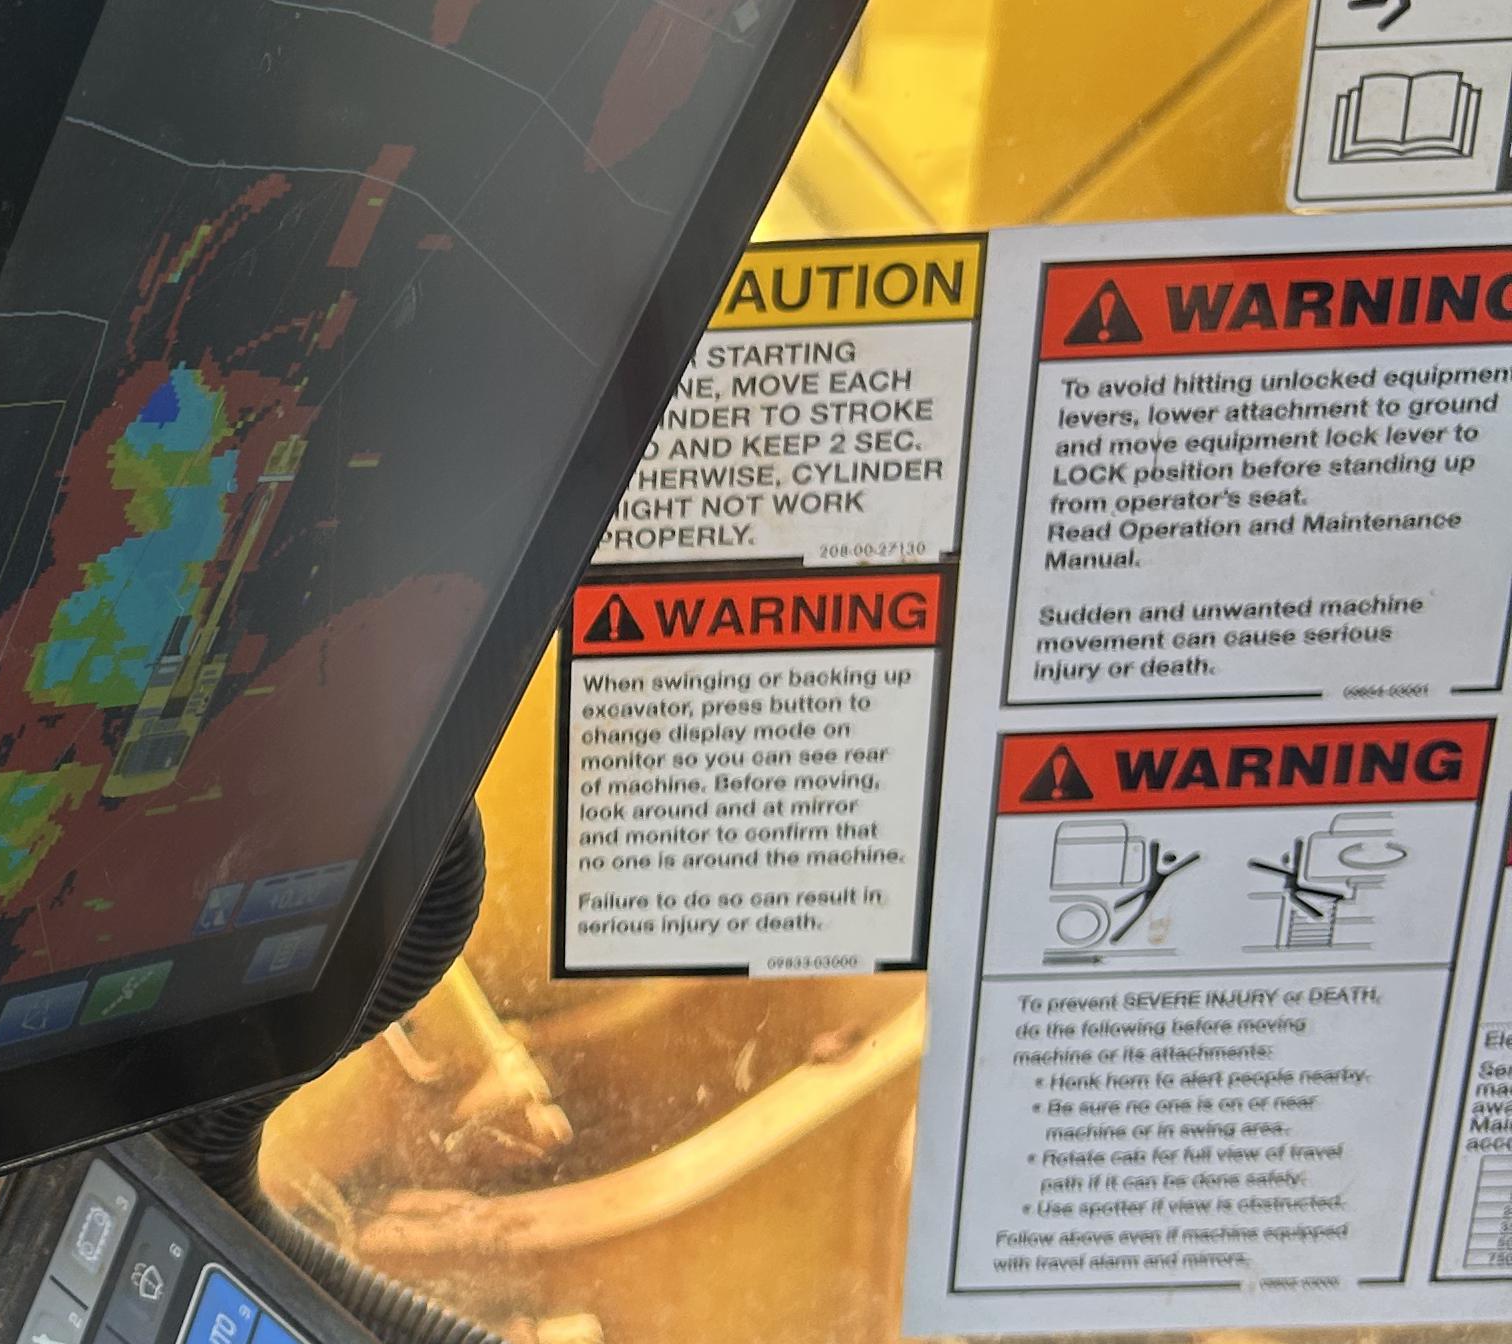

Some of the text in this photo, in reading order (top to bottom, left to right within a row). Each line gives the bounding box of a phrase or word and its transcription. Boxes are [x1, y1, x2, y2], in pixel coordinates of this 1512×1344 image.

[724, 260, 965, 315] AUTION
[706, 339, 856, 369] STARTING
[731, 371, 820, 398] MOVE
[829, 367, 912, 394] EACH
[1060, 362, 1512, 400] To avoid hitting unlocked equipmen
[658, 397, 934, 432] INDER TO STROKE
[1058, 391, 1500, 430] levers, lower attachment to ground
[668, 437, 733, 460] AND
[741, 433, 821, 458] KEEP
[828, 431, 846, 455] 2
[854, 428, 922, 454] SEC.
[1054, 423, 1480, 460] and move equipment lock lever to
[632, 457, 943, 492] HERWISE, CYLINDER
[1052, 453, 1476, 489] LOCK position before standing up
[614, 490, 864, 523] IGHT NOT WORK
[1050, 486, 1308, 516] from operator's seat.
[1047, 512, 1463, 544] Read Operation and Maintenance
[1044, 547, 1141, 571] Manual.
[653, 591, 927, 639] WARNING
[1038, 594, 1424, 627] Sudden and unwanted machine
[1036, 625, 1394, 654] movement can cause serious
[582, 666, 912, 694] When swinging or backing up
[1033, 655, 1216, 684] injury or death.
[581, 693, 872, 720] excavator, press button to
[581, 721, 852, 748] change display mode on
[580, 747, 889, 772] monitor so you can see rear
[1114, 739, 1464, 793] WARNING
[580, 770, 880, 797] of machine. Before moving,
[579, 797, 859, 822] look around and at mirror
[578, 821, 878, 847] and monitor to confirm that
[578, 845, 906, 872] no one is around the machine.
[578, 885, 883, 911] Failure to do so can result in
[577, 912, 823, 937] serious injury or death.
[169, 1242, 184, 1258] 6
[68, 1311, 83, 1329] 2
